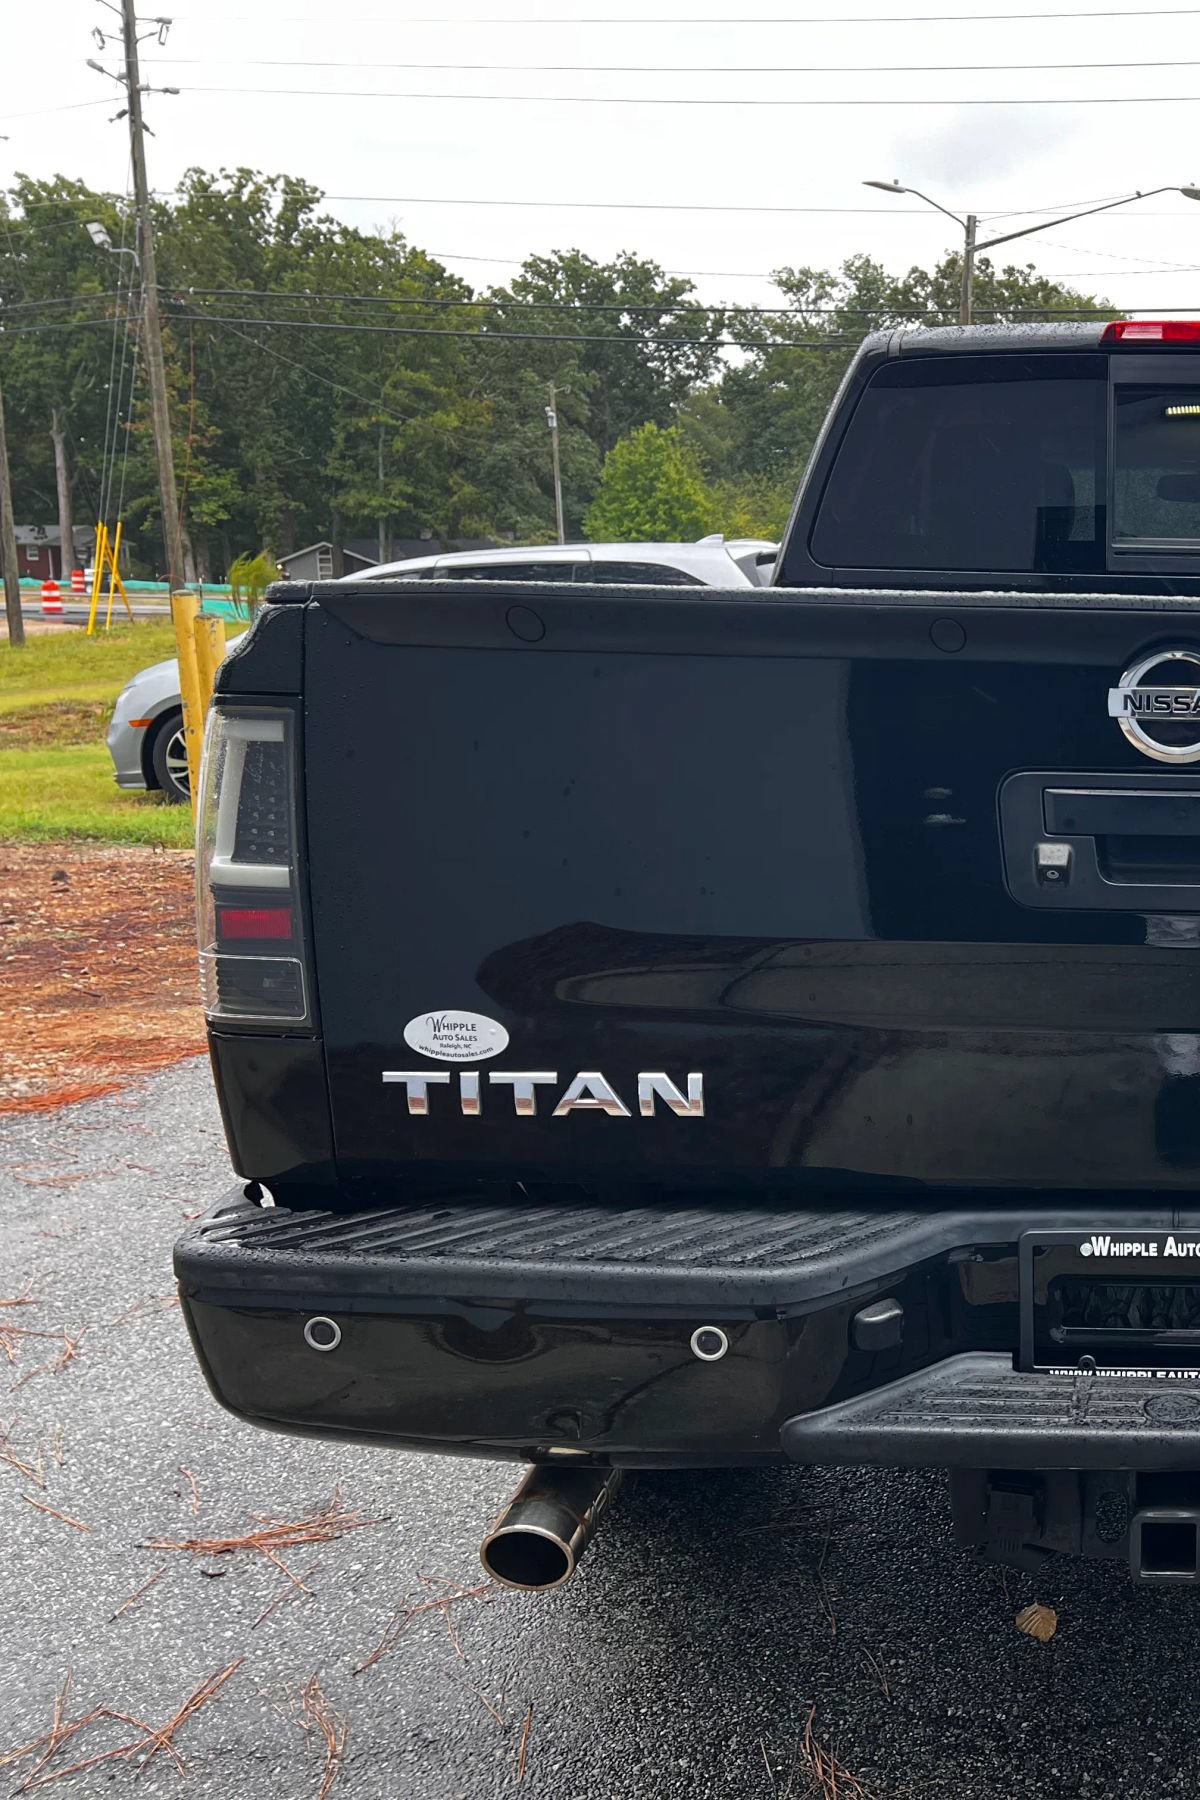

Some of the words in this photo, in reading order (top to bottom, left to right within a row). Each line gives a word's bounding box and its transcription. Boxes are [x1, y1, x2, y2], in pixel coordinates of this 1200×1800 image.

[426, 1014, 477, 1032] WHIPPLE
[432, 1033, 454, 1041] AUTO
[455, 1034, 478, 1042] SALES
[382, 1071, 704, 1117] TITAN
[1091, 1236, 1158, 1257] WHIPPLE
